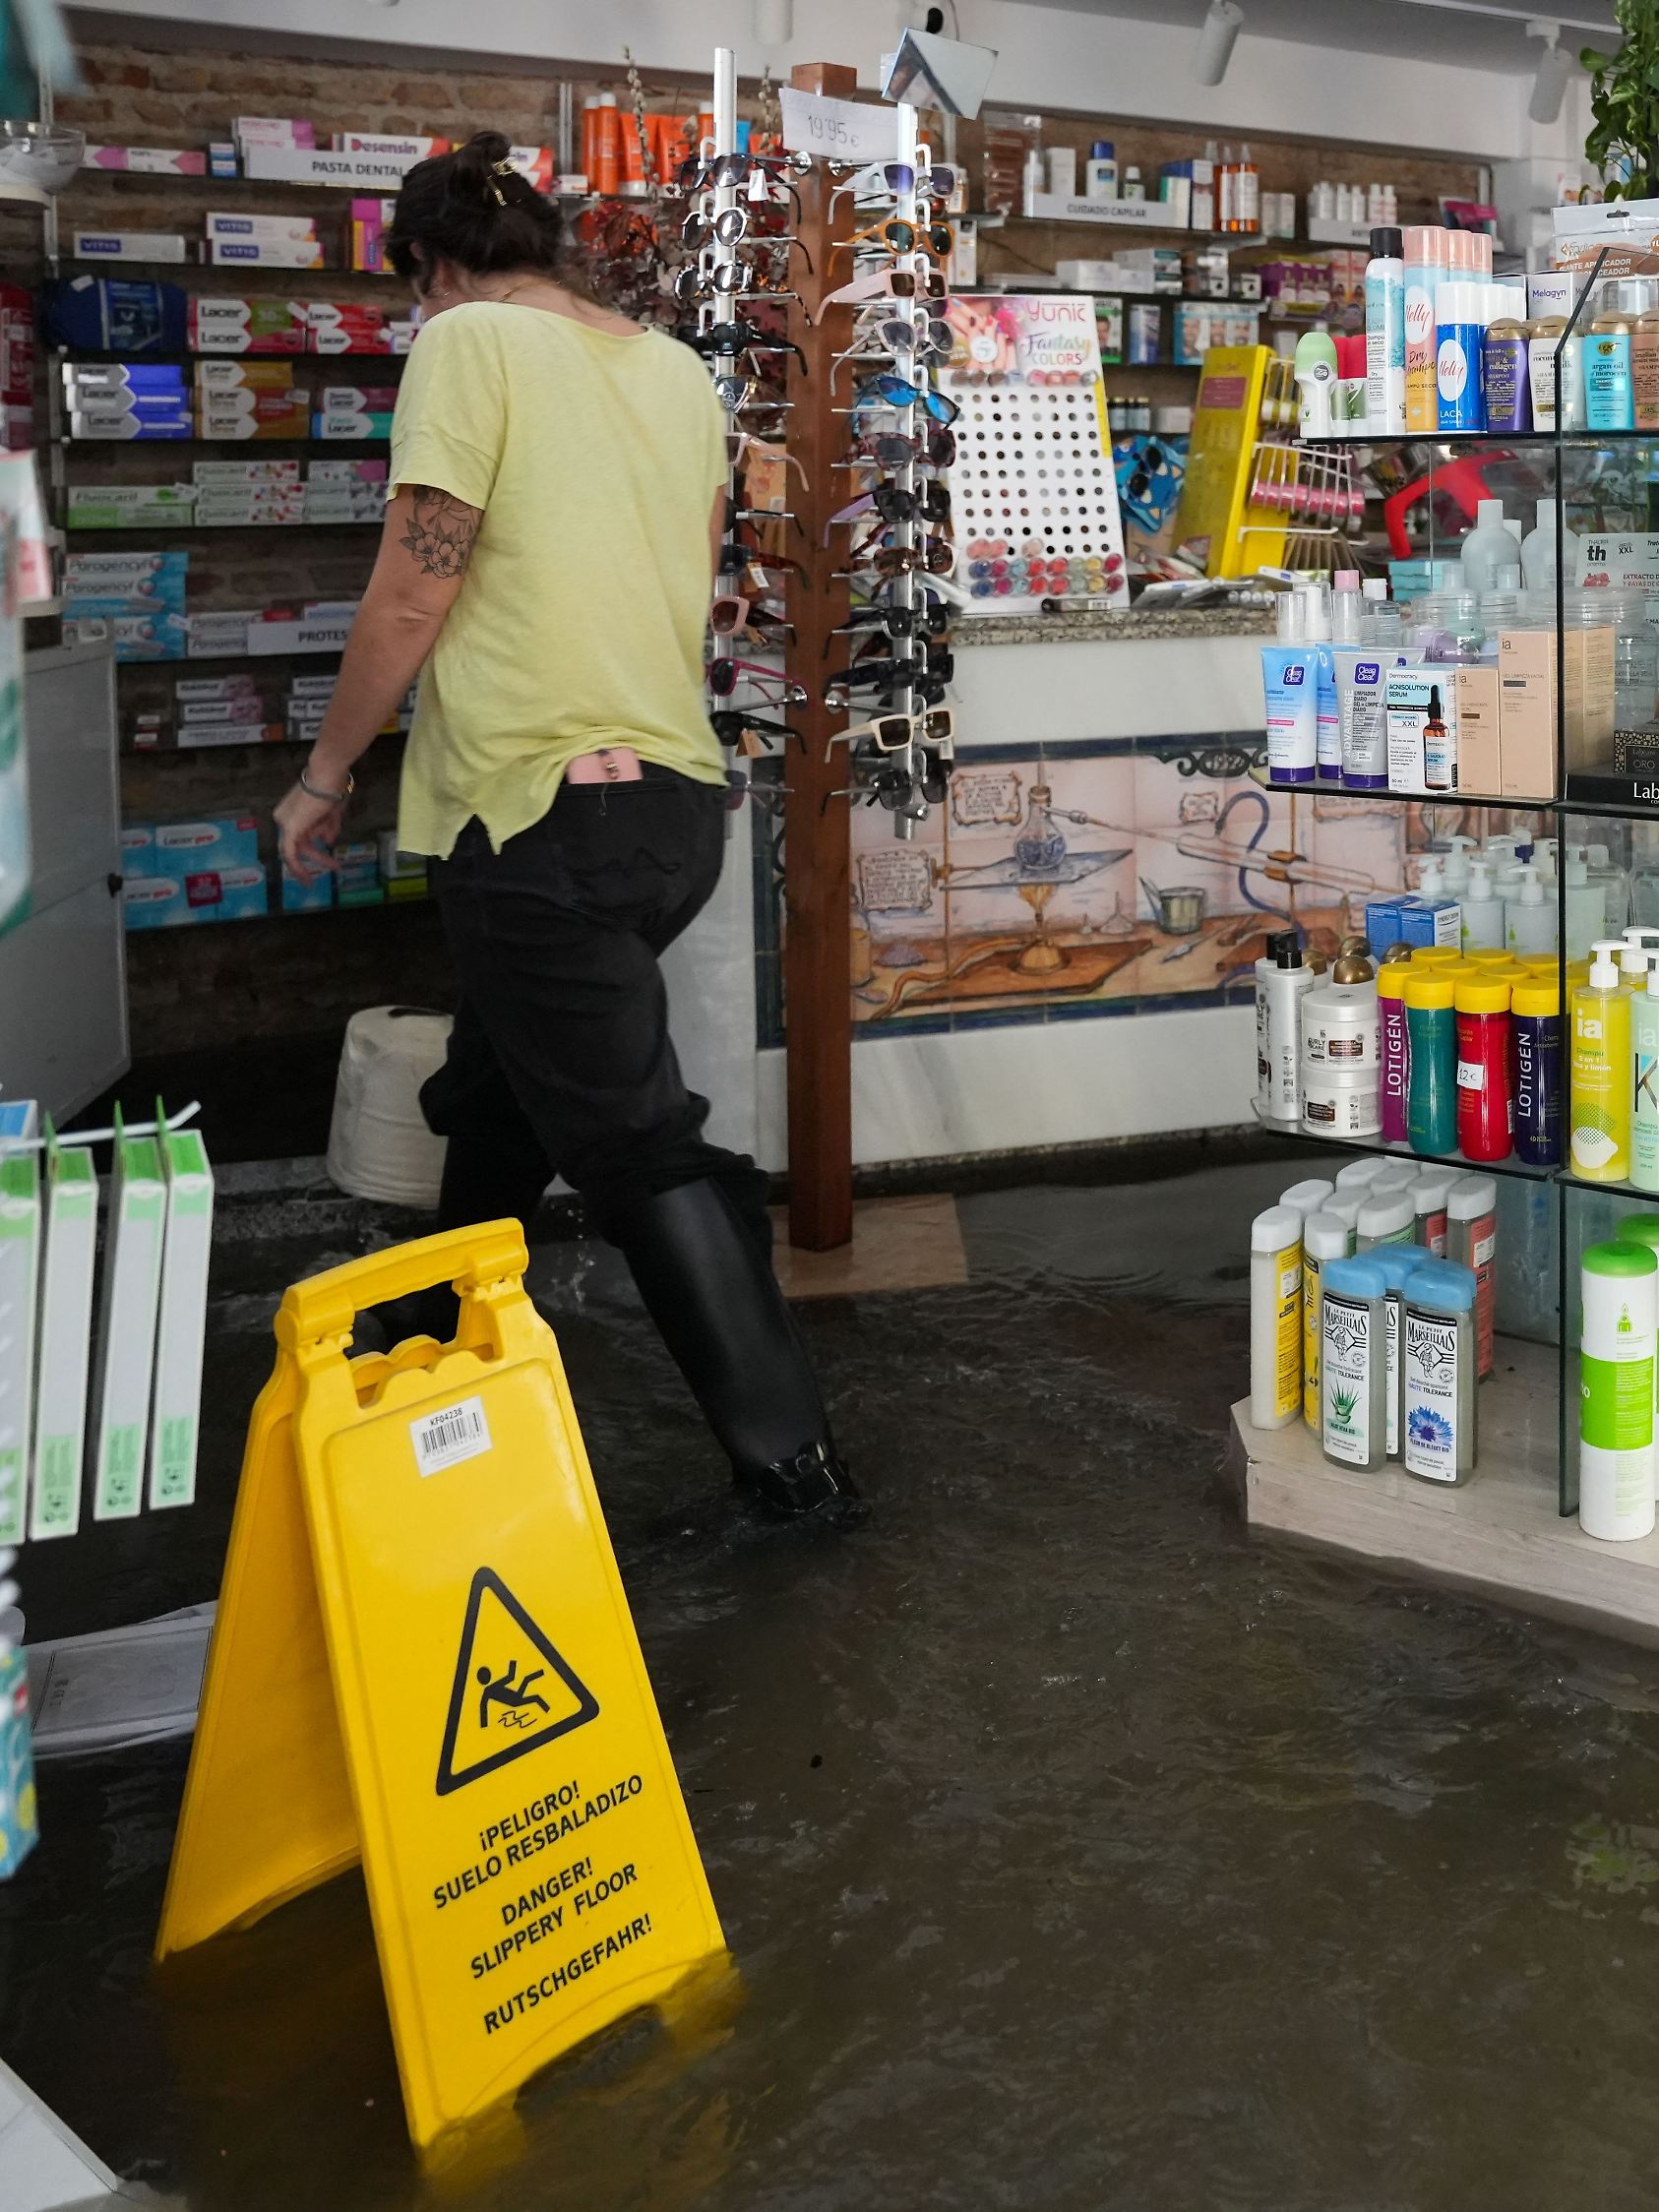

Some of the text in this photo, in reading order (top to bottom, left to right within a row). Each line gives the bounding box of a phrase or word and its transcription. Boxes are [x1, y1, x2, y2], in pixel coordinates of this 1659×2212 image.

[351, 138, 417, 154] Desensin
[312, 160, 403, 177] PASTA DENTAL
[1067, 204, 1147, 217] CUIDADO CAPILAR
[1532, 289, 1567, 299] Melagyn
[202, 306, 242, 318] Lacer
[202, 333, 241, 343] Lacer
[1025, 331, 1092, 362] Fantasy
[1032, 353, 1082, 365] COLORS
[1409, 351, 1427, 363] Dry
[1489, 361, 1517, 372] collagen
[1592, 363, 1612, 372] argan
[1440, 409, 1463, 418] LACA
[328, 423, 358, 433] Lacer
[1586, 545, 1607, 561] th
[1619, 546, 1634, 555] XXL
[299, 629, 348, 643] PROTES
[1502, 638, 1511, 649] ia
[1344, 689, 1354, 759] ADVANTAGE
[1633, 760, 1655, 769] ORO
[1576, 1008, 1603, 1040] ia
[1386, 1014, 1402, 1097] LOTIGÉN
[1517, 1033, 1531, 1118] LOTIGÉN
[1324, 1304, 1367, 1335] MARSEILLAIS
[1407, 1320, 1455, 1352] MARSEILLAIS
[1337, 1369, 1365, 1381] TOLERANCE
[1423, 1386, 1452, 1398] TOLERANCE
[479, 1780, 580, 1852] ¡PELIGRO!
[434, 1774, 643, 1909] SUELO RESBALADIZO
[501, 1857, 592, 1926] DANGER!
[470, 1863, 638, 1979] SLIPPERY FLOOR
[483, 1913, 652, 2035] RUTSCHGEFAHR!
